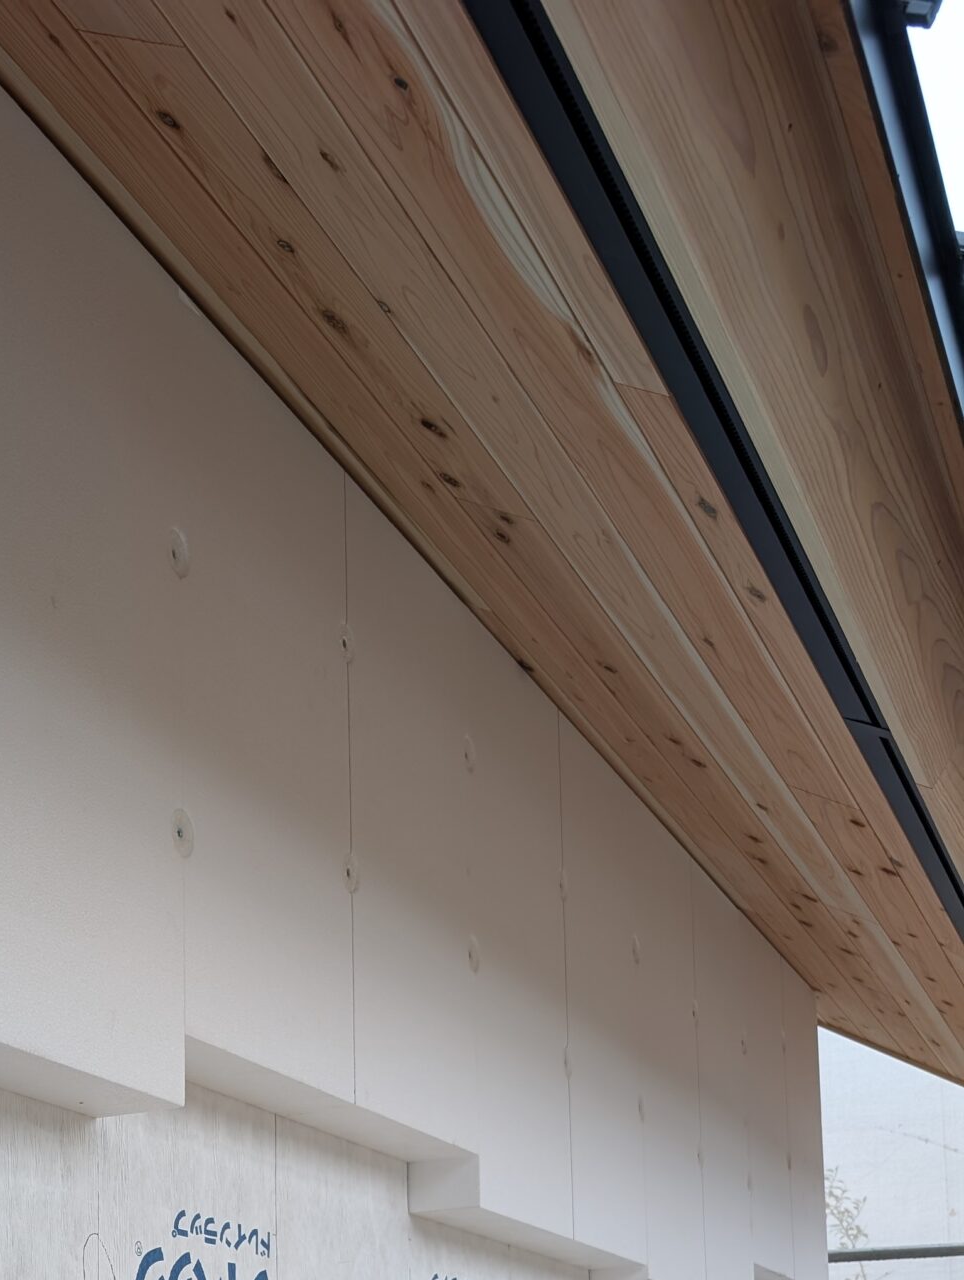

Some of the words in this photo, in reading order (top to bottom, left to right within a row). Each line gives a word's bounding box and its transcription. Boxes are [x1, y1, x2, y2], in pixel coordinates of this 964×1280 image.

[171, 1209, 271, 1259] ドレインラップ
